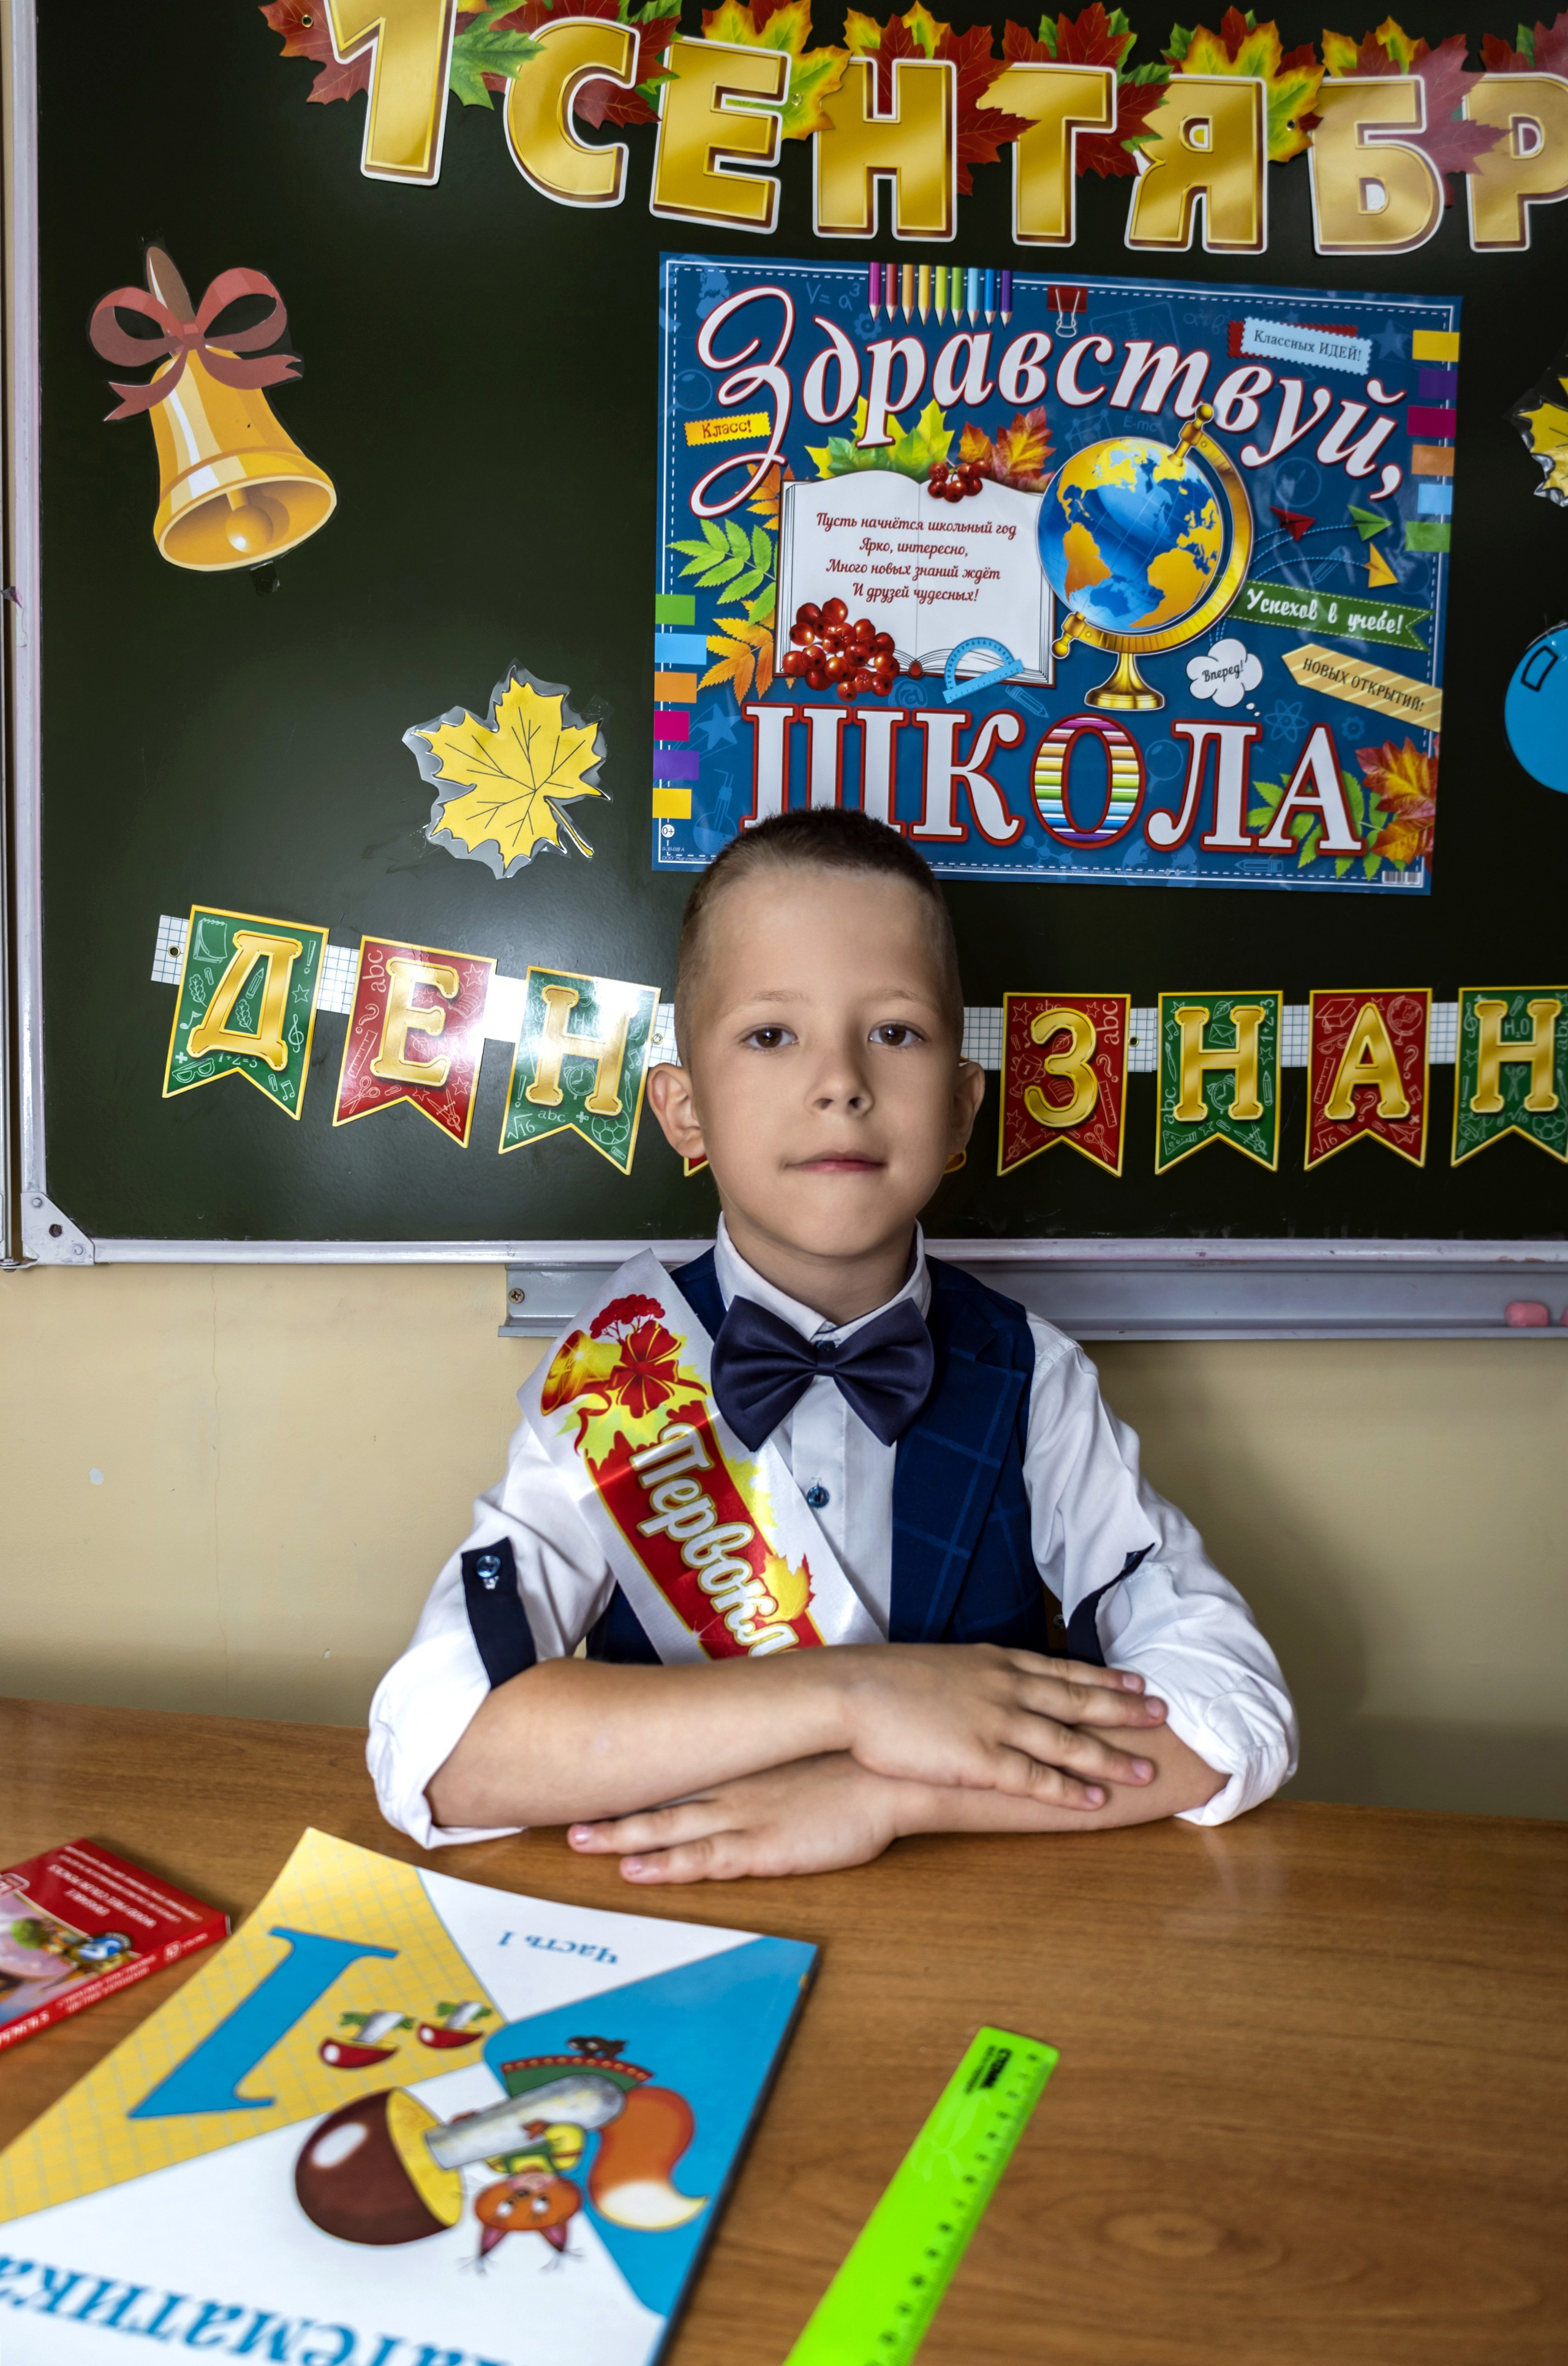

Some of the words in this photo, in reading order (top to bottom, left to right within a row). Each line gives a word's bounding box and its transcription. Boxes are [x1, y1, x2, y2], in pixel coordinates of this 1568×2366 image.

[325, 0, 459, 186] 1
[503, 17, 1568, 256] СЕНТЯБР
[1254, 330, 1316, 353] Классных
[1319, 342, 1362, 361] ИДЕЙ!
[688, 284, 1407, 518] Здравствуй,
[701, 420, 752, 439] Класс!
[816, 512, 858, 532] Пусть
[861, 517, 924, 531] начнётся
[927, 521, 993, 534] школьный
[995, 524, 1017, 541] год
[859, 537, 893, 557] Ярко,
[897, 543, 968, 560] интересно,
[826, 559, 868, 574] Много
[870, 562, 911, 575] новых
[912, 565, 959, 581] знаний
[962, 567, 1001, 585] ждёт
[853, 582, 864, 597] И
[865, 585, 910, 604] друзей
[913, 588, 979, 605] чудесных!
[1246, 588, 1317, 621] Успехов
[1327, 602, 1338, 624] в
[1348, 610, 1404, 635] учебе!
[1202, 659, 1244, 682] Вперед!
[1302, 657, 1351, 685] НОВЫХ
[1350, 675, 1425, 712] ОТКРЫТИЙ!
[741, 703, 1366, 856] ШКОЛА
[662, 826, 674, 836] 0+
[362, 950, 387, 993] abc
[1096, 1000, 1120, 1045] abc
[538, 1108, 567, 1123] abc
[497, 1930, 518, 1948] 1
